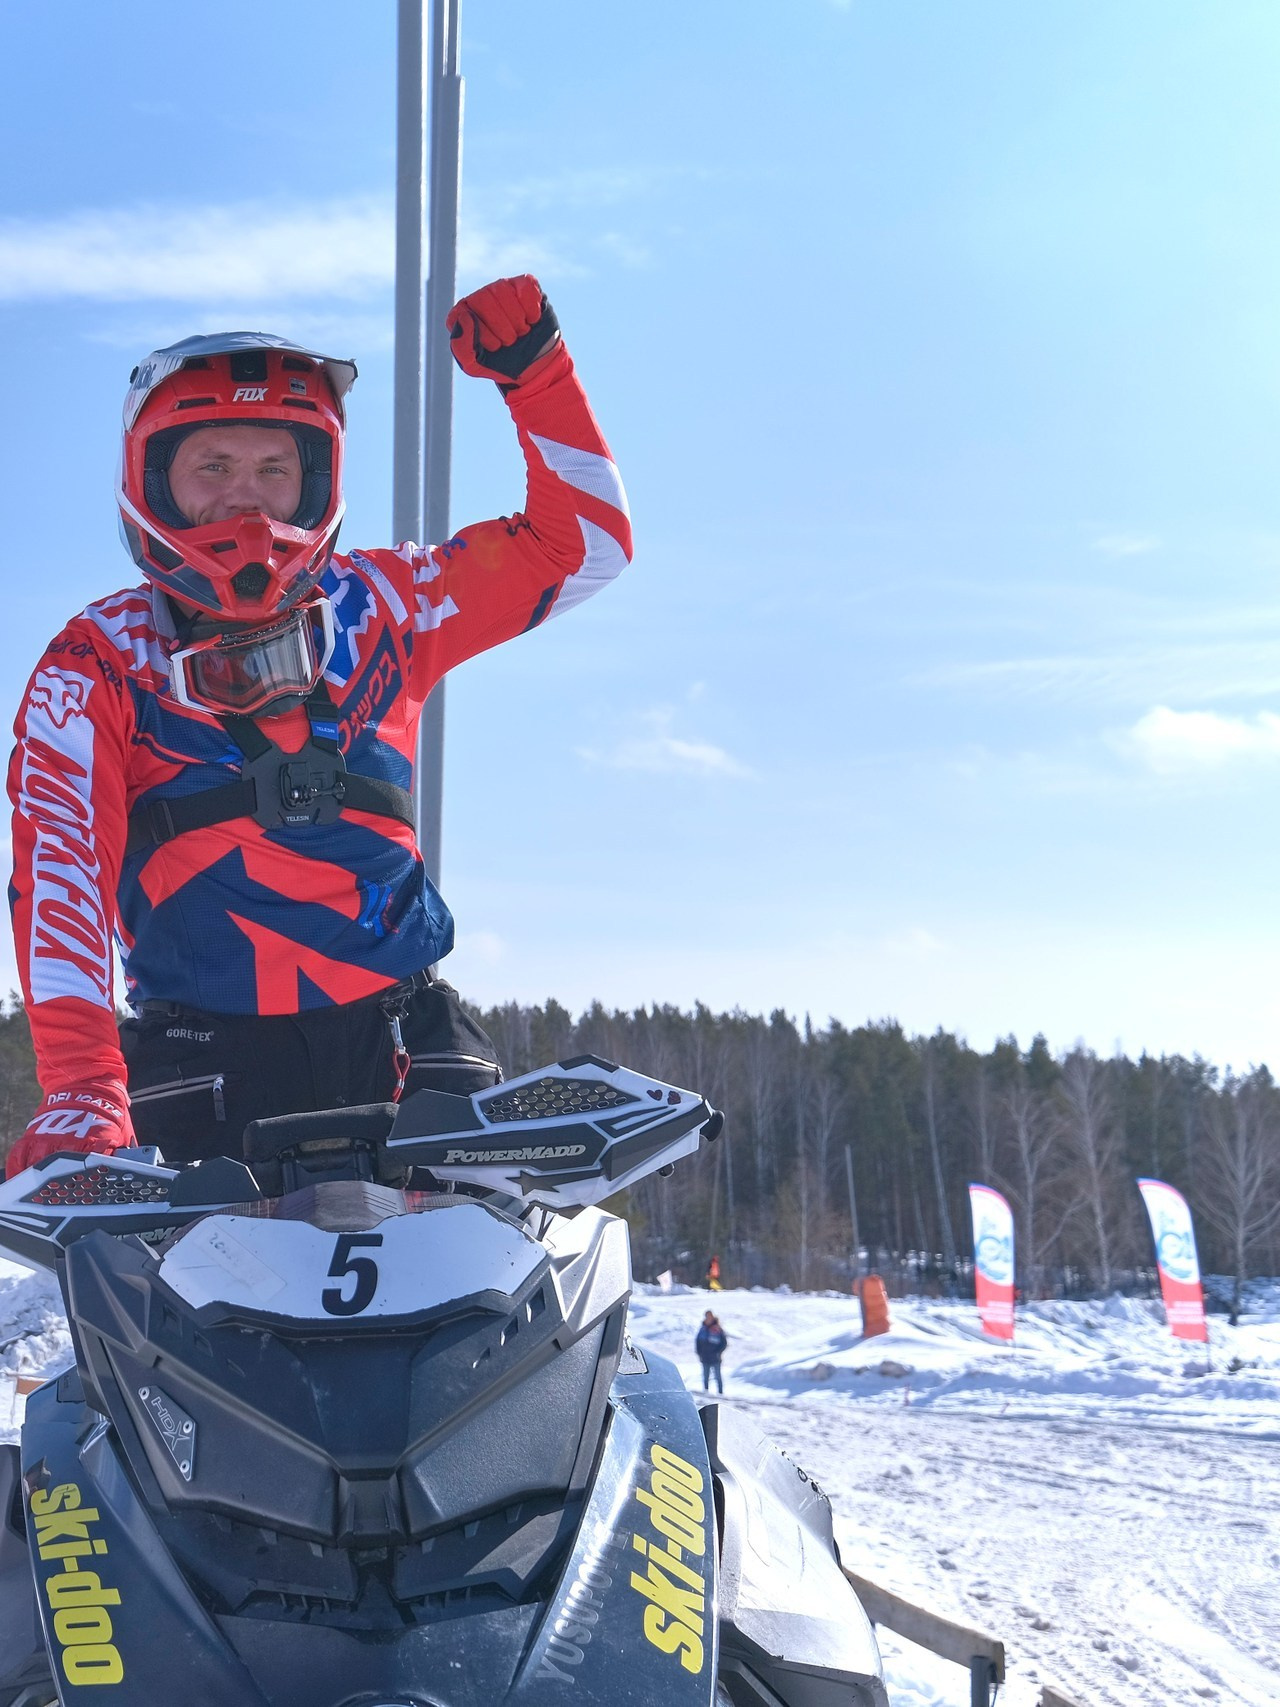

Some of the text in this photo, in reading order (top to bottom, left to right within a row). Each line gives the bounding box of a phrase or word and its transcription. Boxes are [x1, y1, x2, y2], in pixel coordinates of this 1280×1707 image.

[232, 387, 269, 402] FOX
[315, 725, 336, 734] TELESIN
[321, 1233, 384, 1316] 5
[30, 1483, 124, 1686] ski-doo
[630, 1443, 706, 1675] ski-doo
